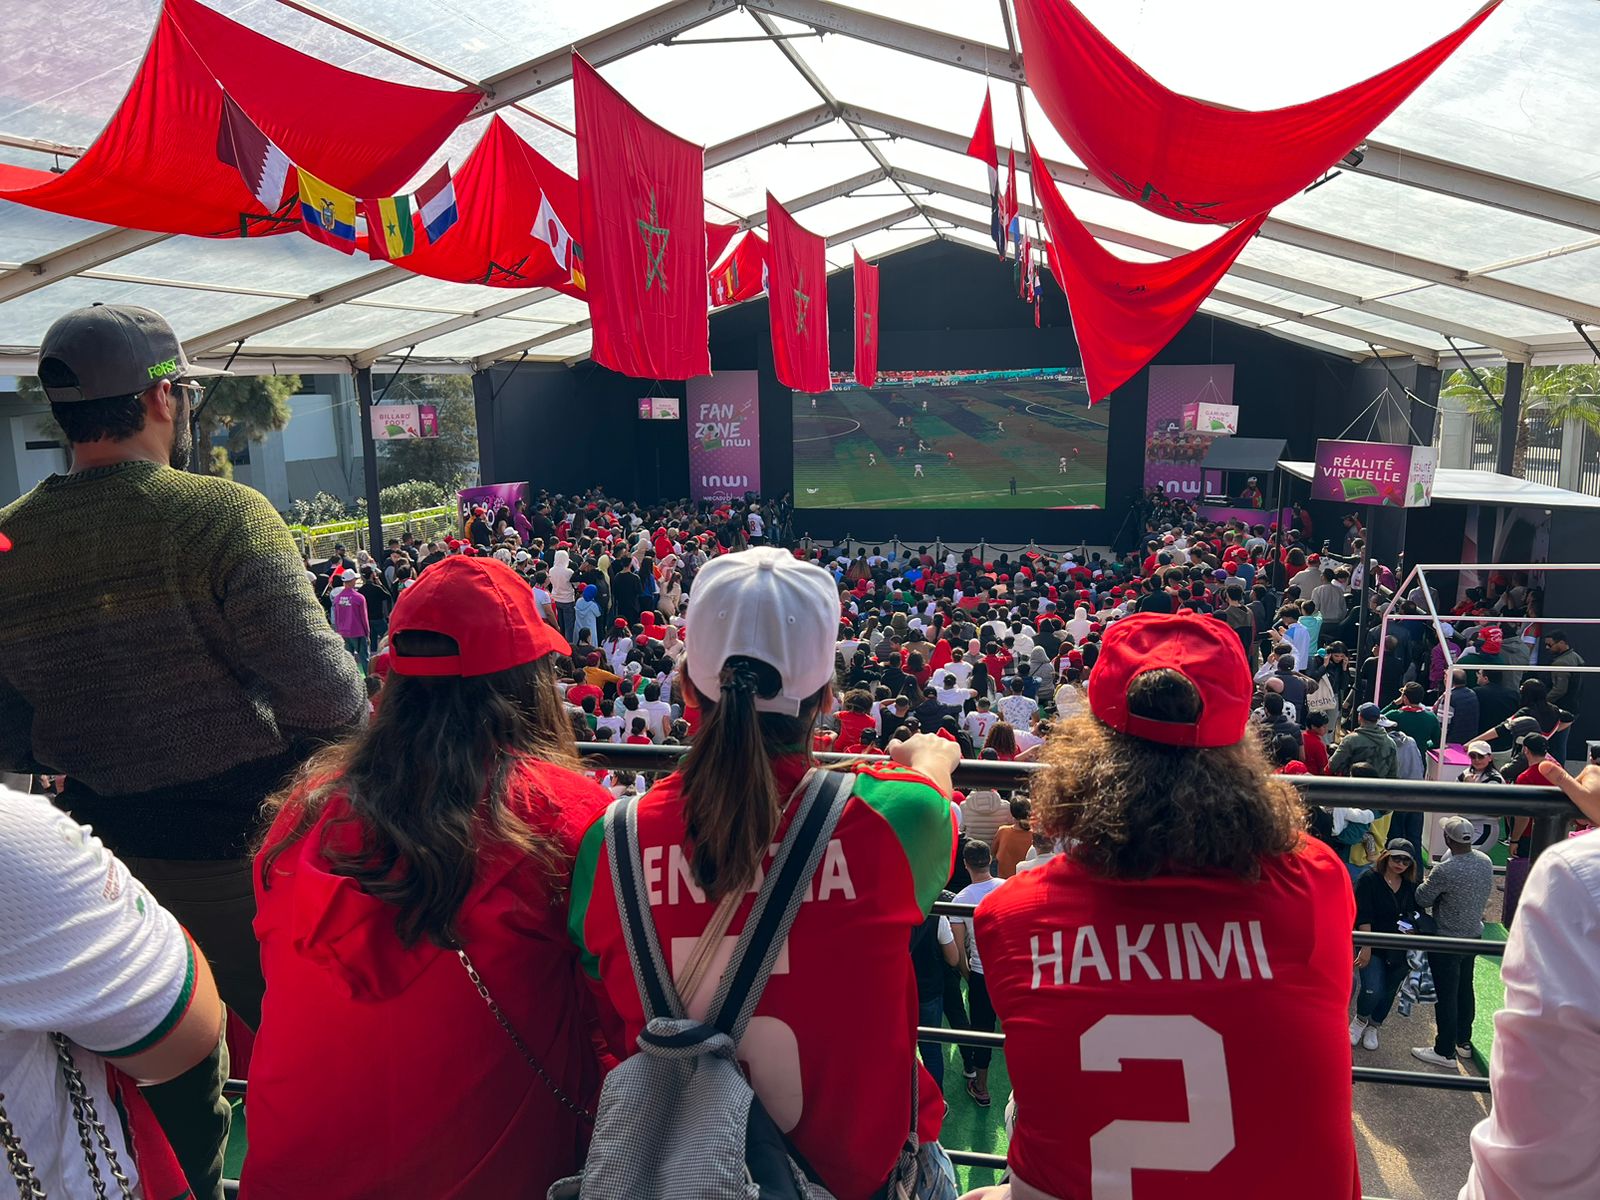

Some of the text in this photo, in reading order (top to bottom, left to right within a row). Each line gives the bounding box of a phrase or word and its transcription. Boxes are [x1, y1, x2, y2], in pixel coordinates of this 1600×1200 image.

[700, 403, 734, 421] FAN
[695, 422, 741, 439] ZONE
[1333, 455, 1395, 471] RÉALITÉ
[702, 475, 748, 487] inwi
[1323, 467, 1401, 482] VIRTUELLE
[978, 721, 986, 737] 2
[1029, 920, 1273, 990] HAKIMI
[1079, 1014, 1236, 1200] 2
